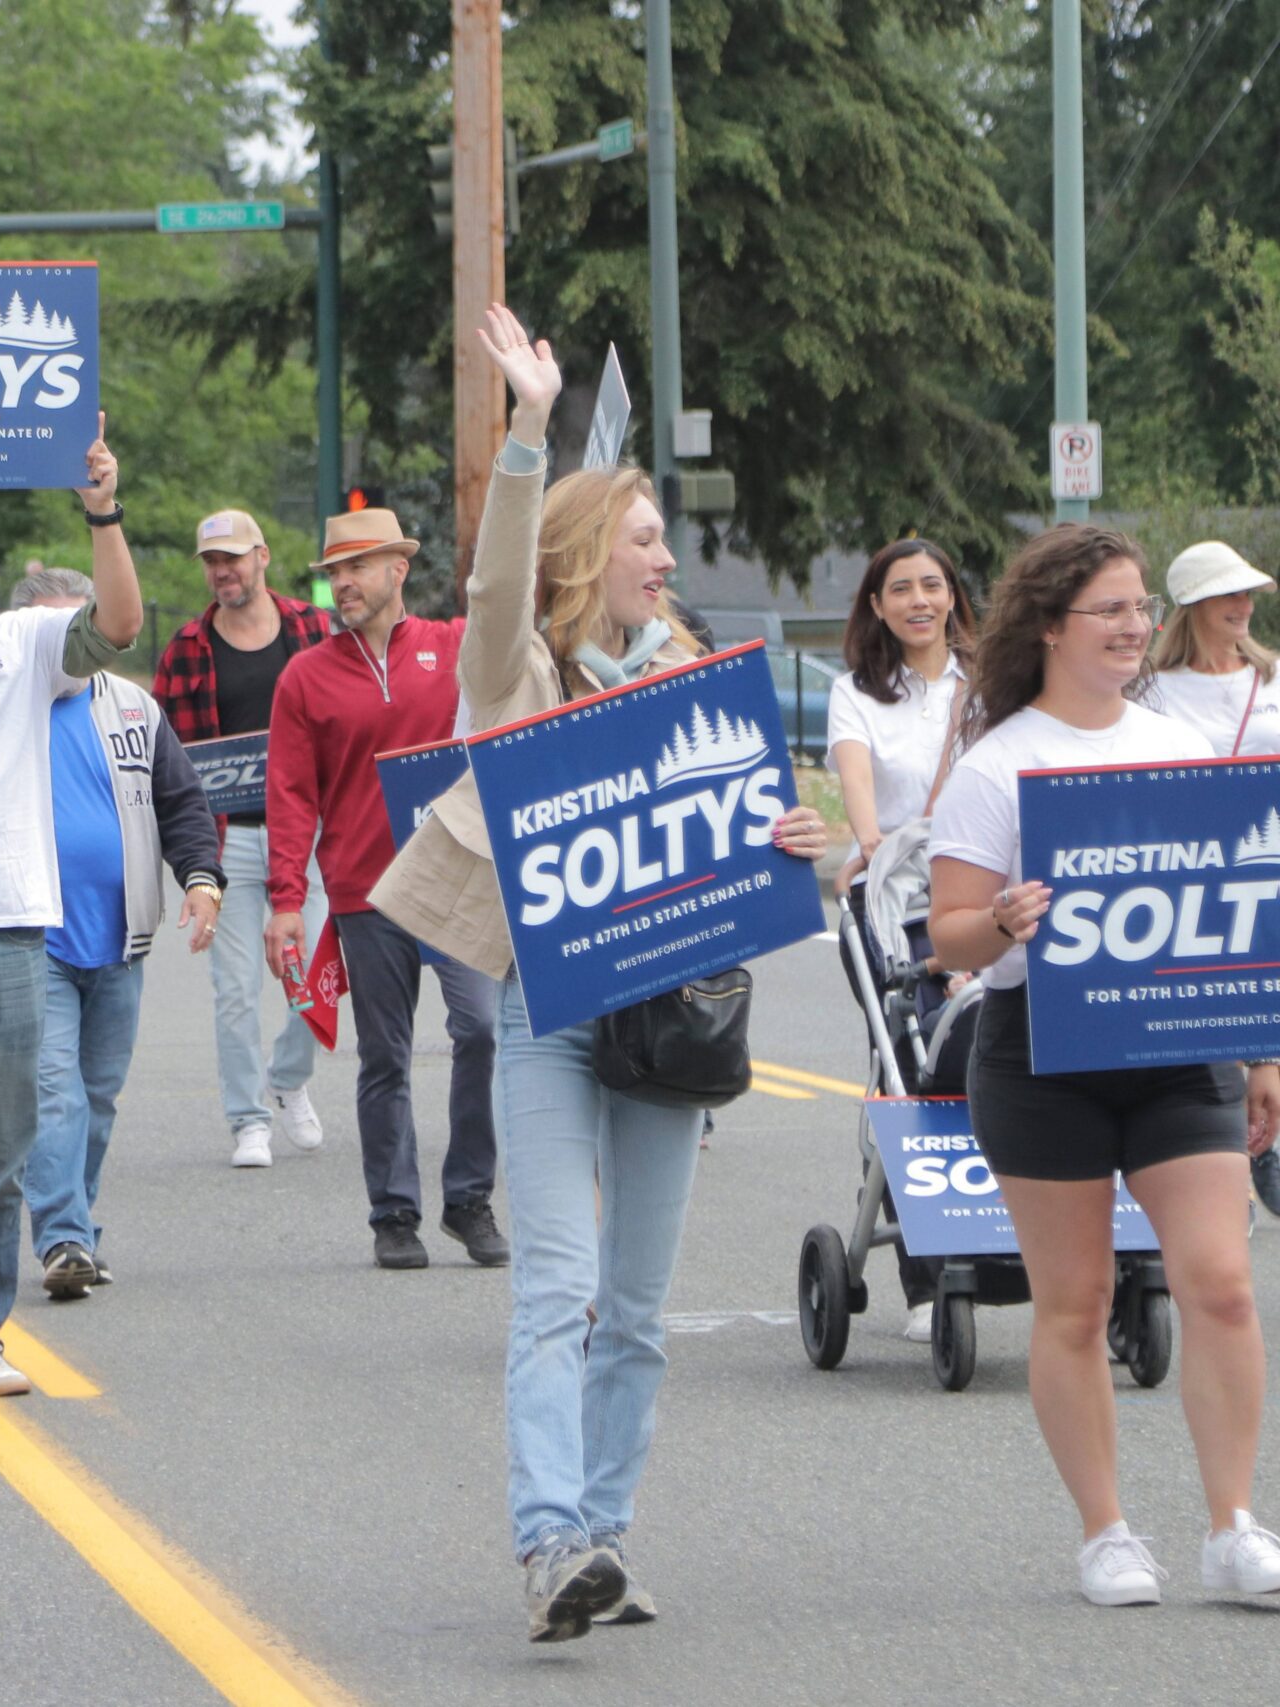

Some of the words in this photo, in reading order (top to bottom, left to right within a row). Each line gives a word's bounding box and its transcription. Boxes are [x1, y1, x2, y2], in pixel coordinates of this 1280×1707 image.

[255, 206, 272, 224] PL
[45, 268, 73, 277] FOR
[35, 427, 54, 440] (R)
[1065, 466, 1089, 477] BIKE
[1064, 481, 1091, 494] LANE
[493, 729, 536, 749] HOME
[546, 719, 561, 732] IS
[570, 698, 623, 723] WORTH
[633, 670, 707, 702] FIGHTING
[716, 656, 745, 674] FOR
[400, 750, 439, 765] HOME
[449, 744, 464, 754] IS
[1051, 775, 1101, 787] HOME
[1116, 773, 1133, 783] IS
[1149, 768, 1213, 781] WORTH
[1228, 763, 1280, 776] FIGH
[511, 767, 651, 840] KRISTINA
[519, 767, 786, 927] SOLTYS
[1052, 840, 1226, 878] KRISTINA
[561, 938, 592, 959] FOR
[595, 923, 631, 947] 47TH
[633, 915, 652, 934] LD
[654, 898, 699, 926] STATE
[700, 878, 754, 910] SENATE
[754, 870, 773, 896] (R)
[1041, 880, 1280, 966] SOLT
[615, 920, 737, 973] KRISTINAFORSENATE.COM
[1086, 990, 1121, 1004] FOR
[1128, 986, 1171, 1001] 47TH
[1177, 985, 1199, 998] LD
[1204, 981, 1259, 996] STATE
[1147, 1013, 1280, 1032] KRISTINAFORSENATE.C
[902, 1135, 981, 1152] KRIST
[943, 1208, 972, 1217] FOR
